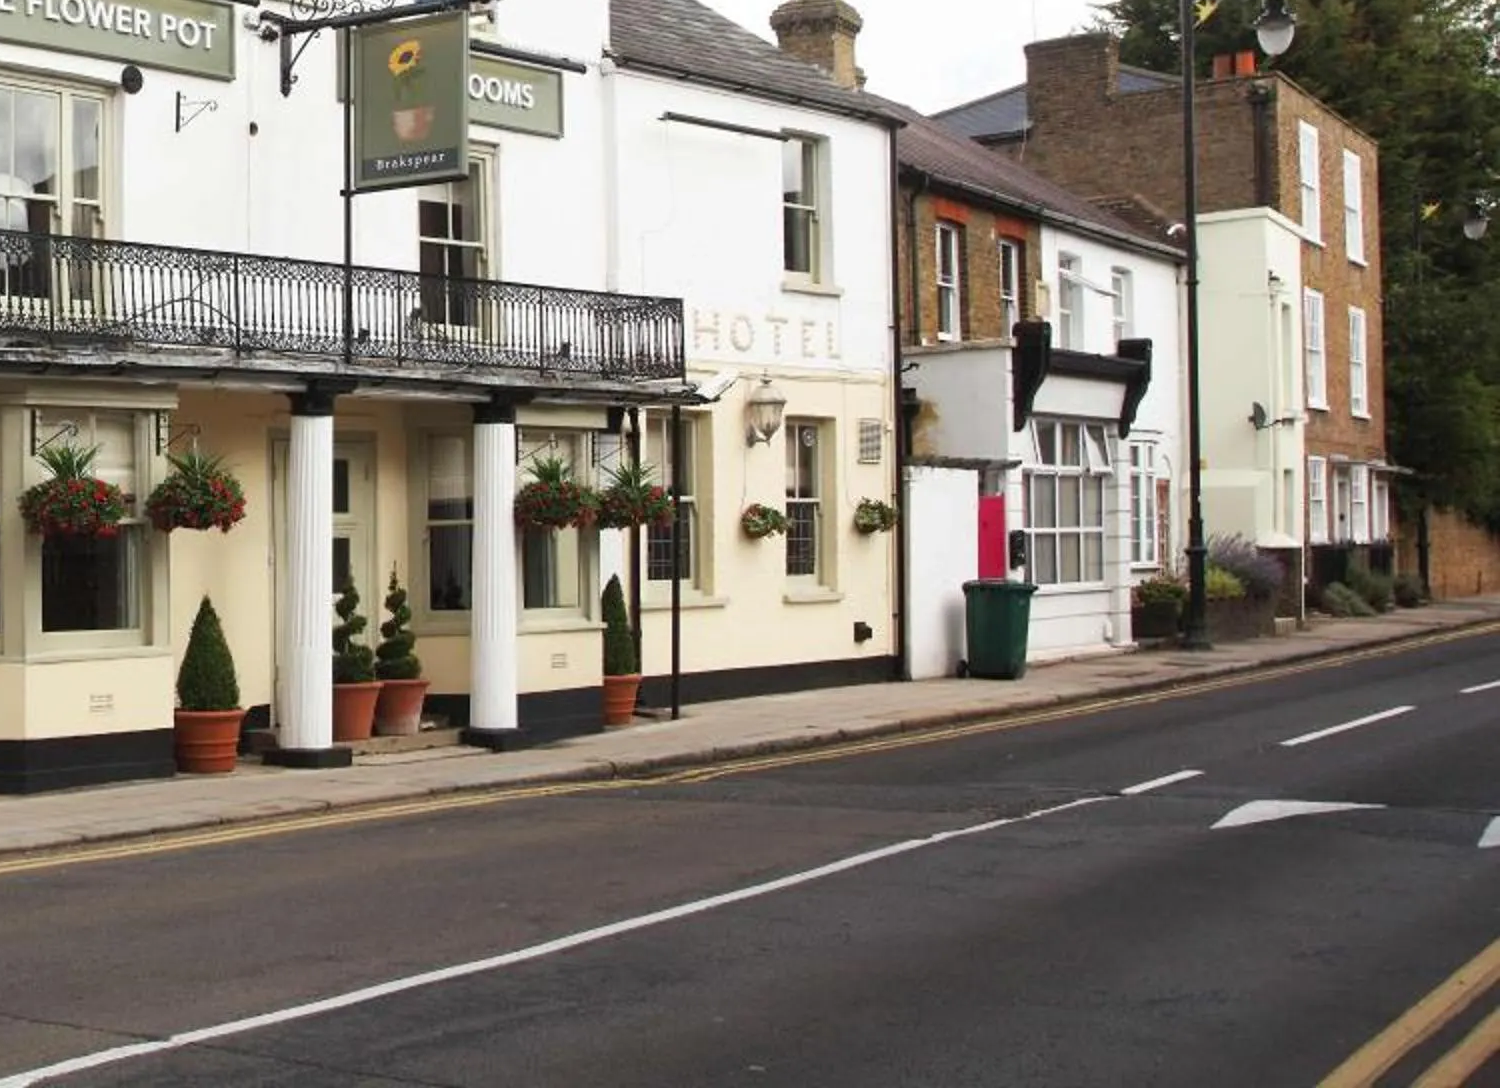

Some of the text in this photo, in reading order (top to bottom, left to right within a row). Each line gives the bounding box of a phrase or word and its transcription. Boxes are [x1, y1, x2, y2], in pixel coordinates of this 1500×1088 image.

[158, 13, 217, 50] POT
[468, 73, 534, 109] OOMS
[693, 310, 842, 358] HOTEL
